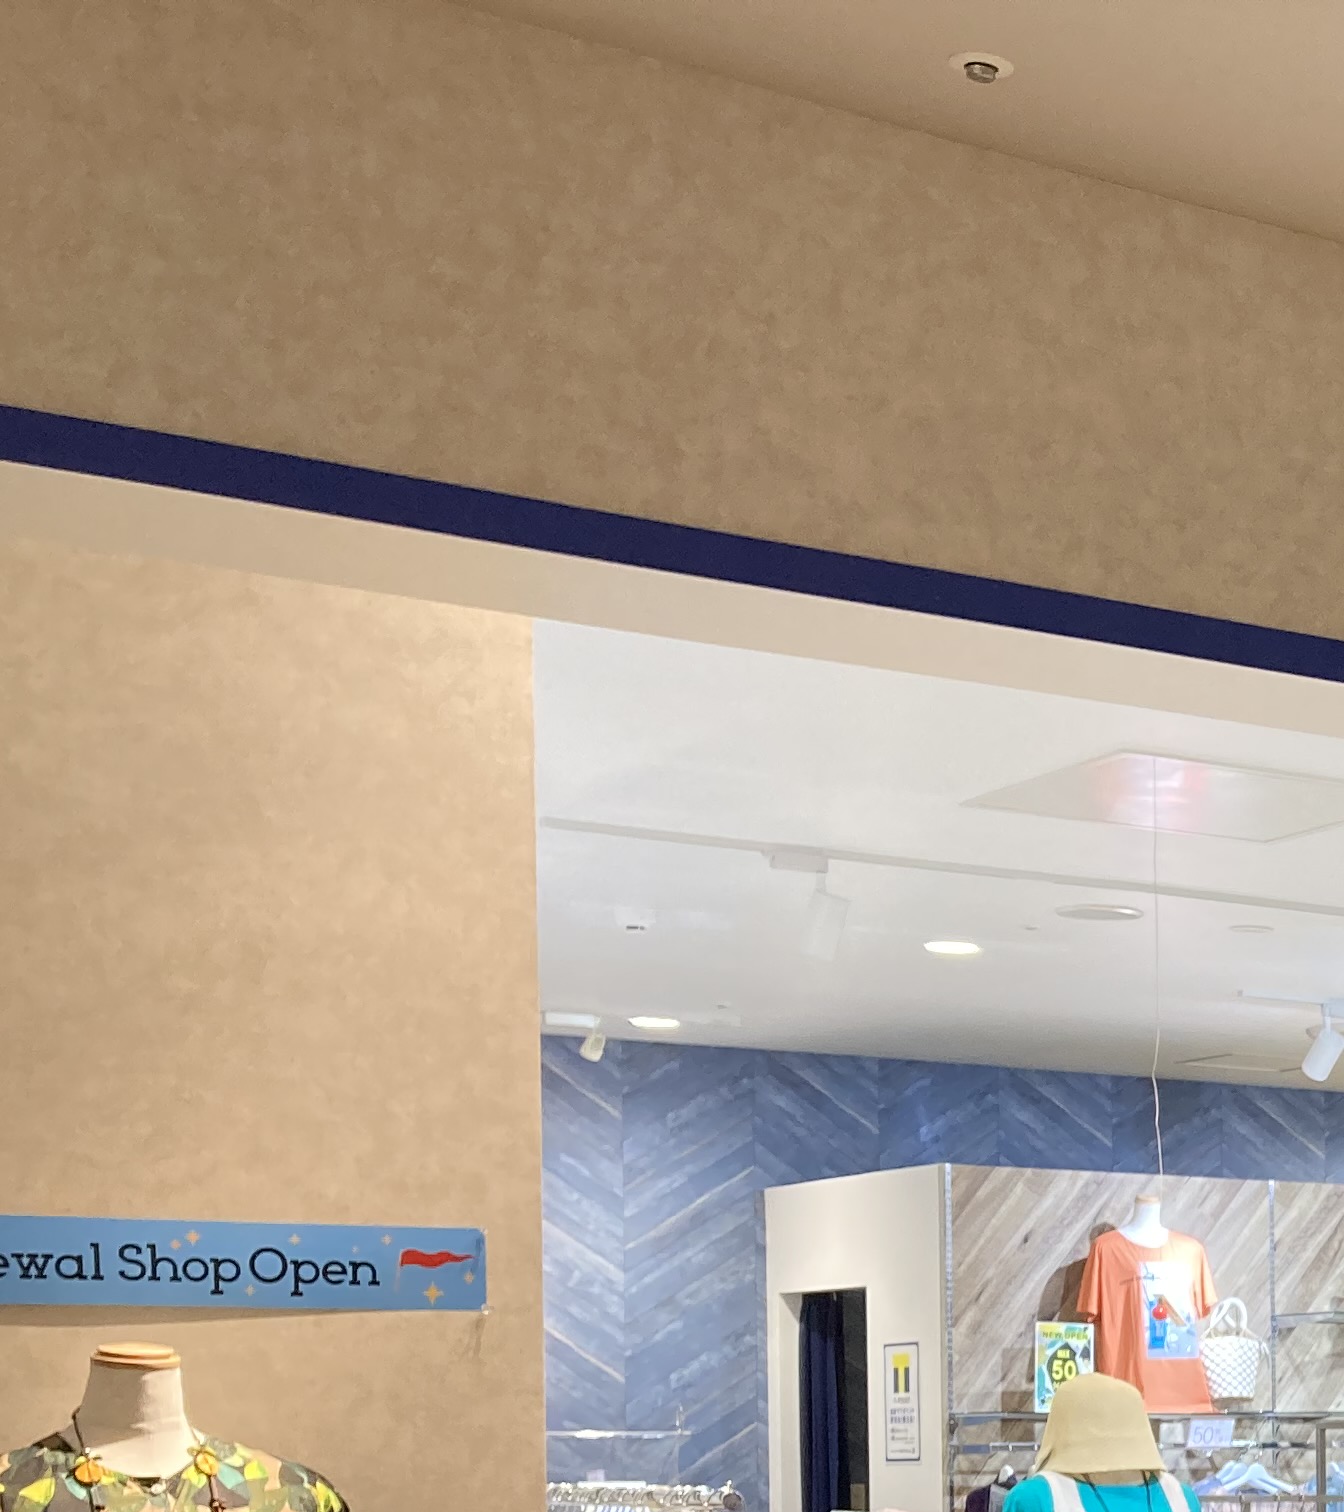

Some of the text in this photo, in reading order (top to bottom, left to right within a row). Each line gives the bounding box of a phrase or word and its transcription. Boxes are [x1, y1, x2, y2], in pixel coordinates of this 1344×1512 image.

[117, 1242, 241, 1296] Shop
[249, 1247, 381, 1298] Open
[1051, 1359, 1077, 1381] 50
